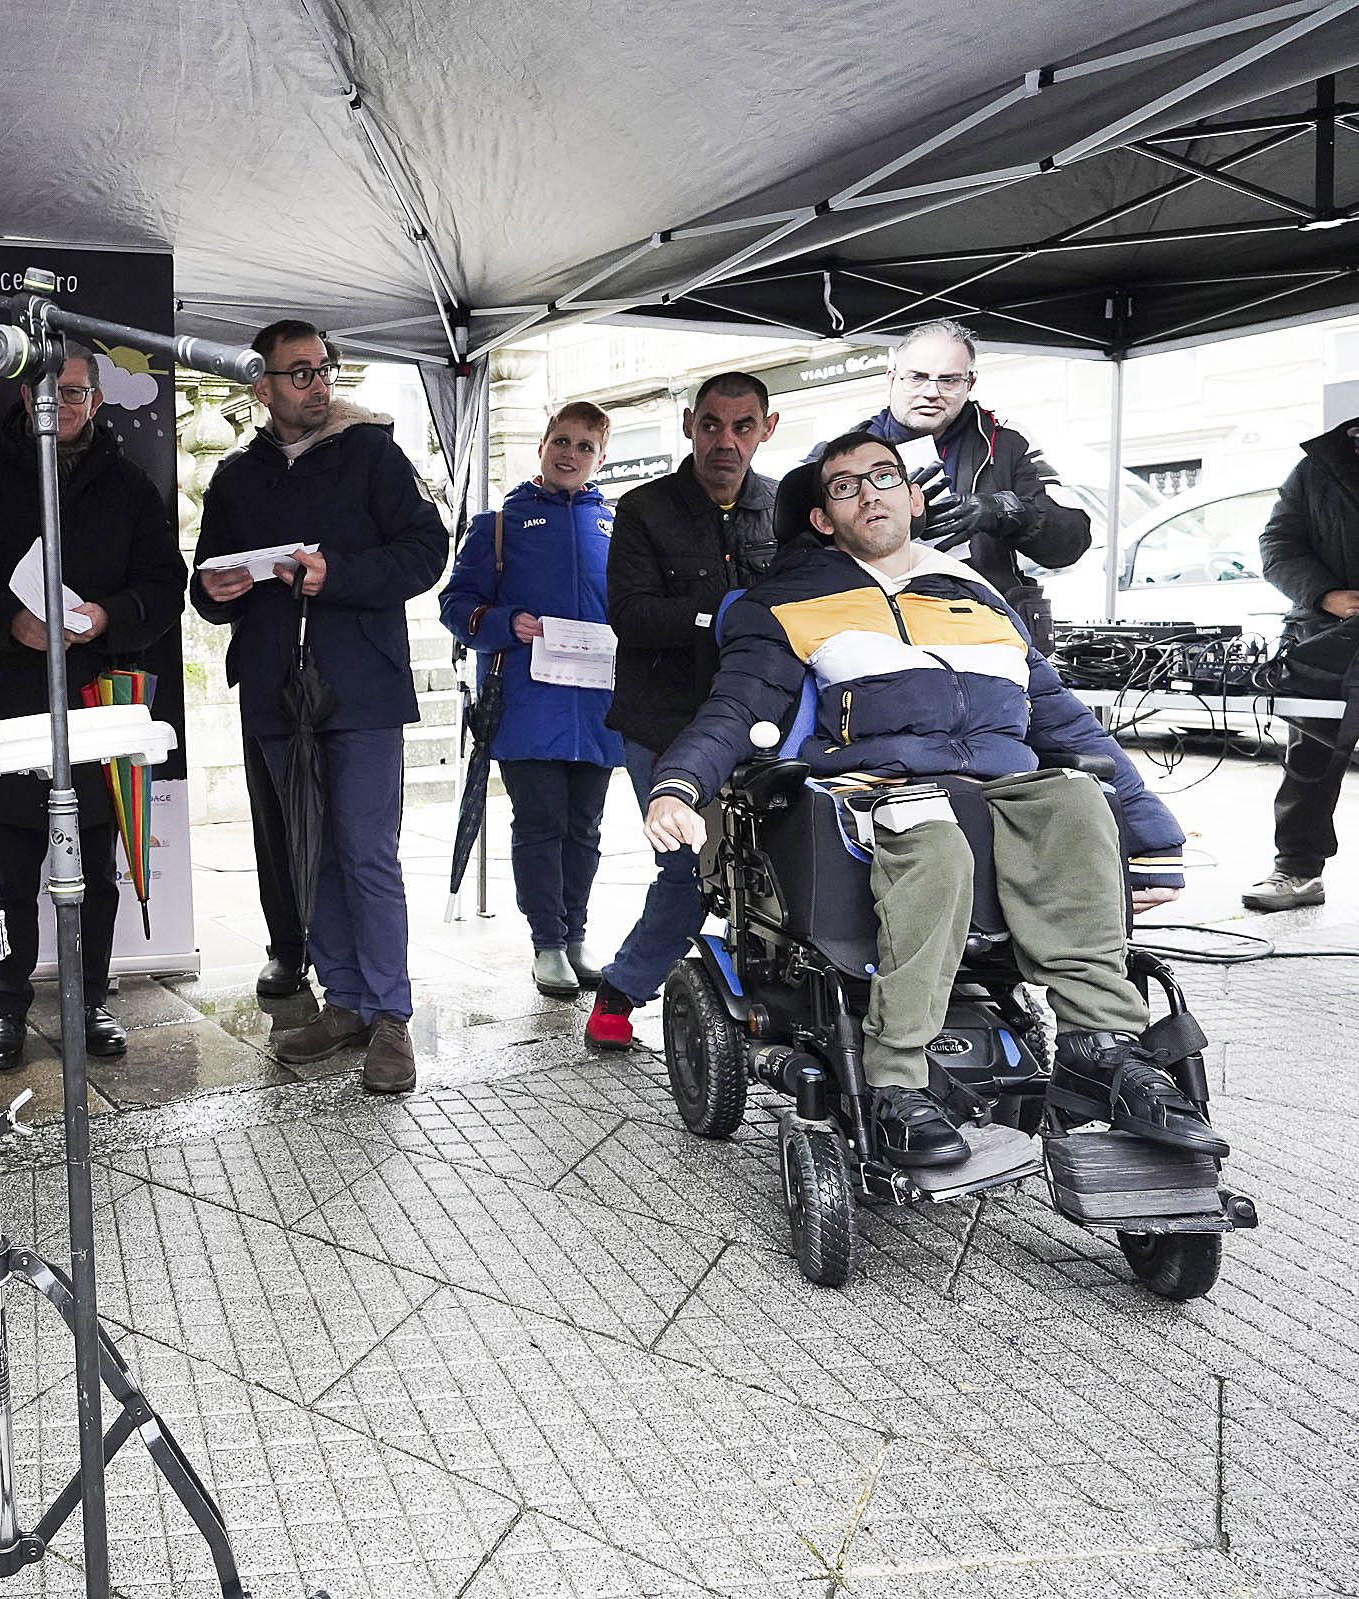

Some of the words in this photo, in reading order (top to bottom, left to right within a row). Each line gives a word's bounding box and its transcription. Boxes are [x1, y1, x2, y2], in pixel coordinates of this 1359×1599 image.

[800, 364, 844, 381] VIAJES
[523, 518, 546, 528] JAKO
[930, 1044, 964, 1052] QUICKIE
